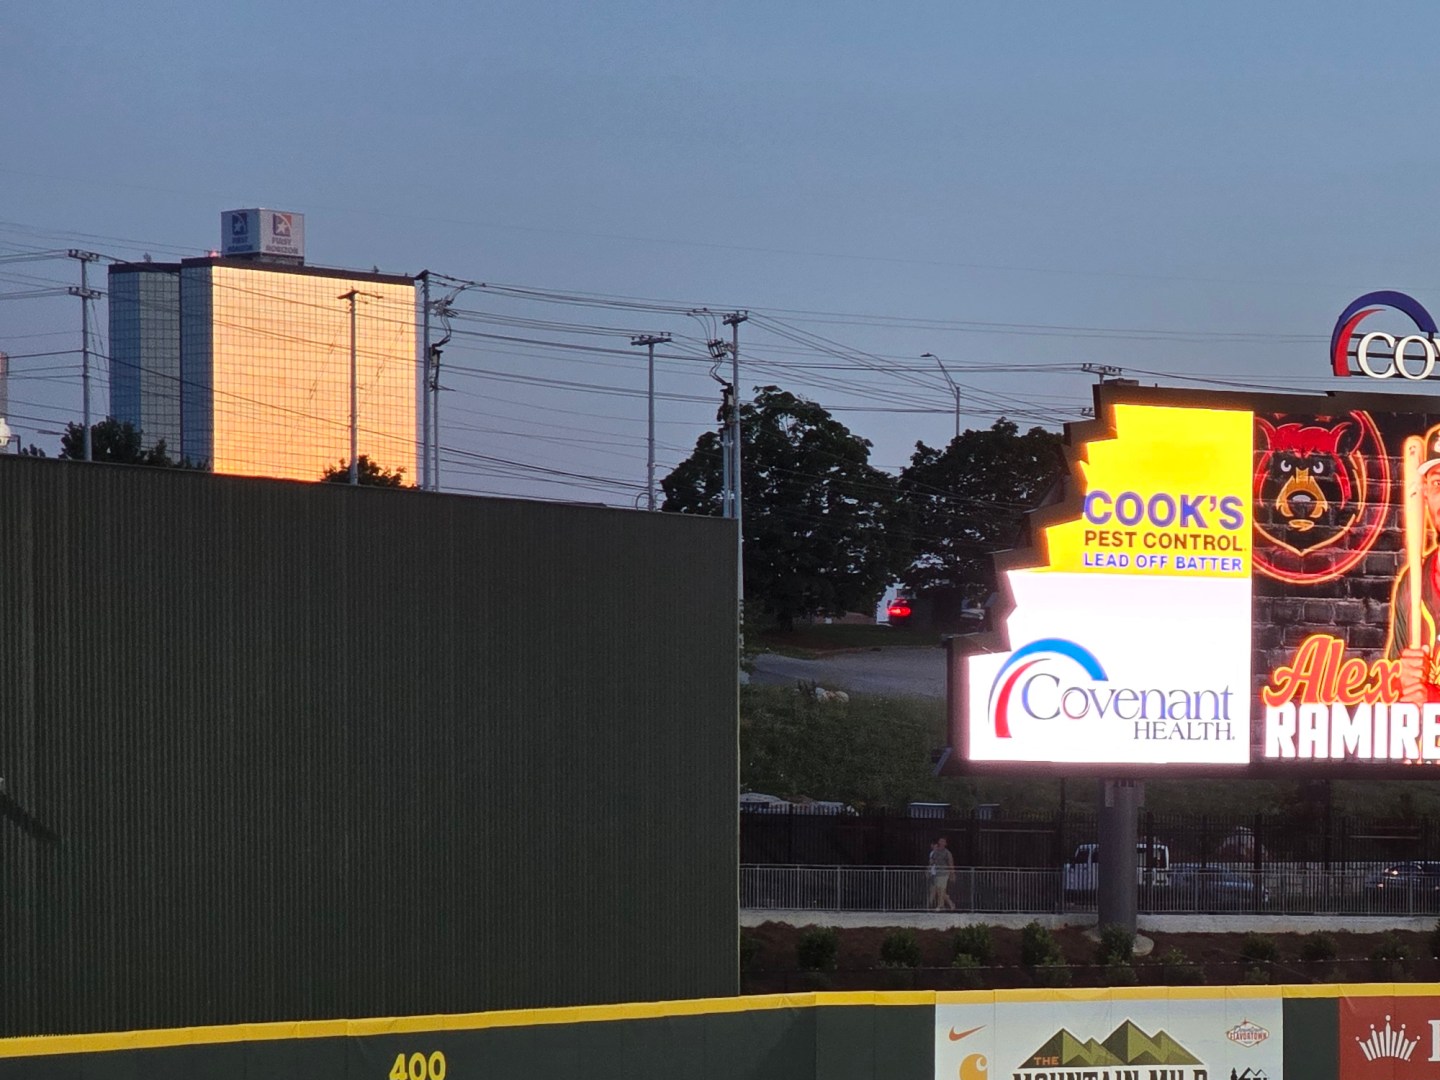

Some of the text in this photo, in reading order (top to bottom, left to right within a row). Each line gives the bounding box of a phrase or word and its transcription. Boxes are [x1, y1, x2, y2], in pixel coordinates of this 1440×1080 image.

[1083, 490, 1245, 530] COOK'S
[1084, 530, 1137, 548] PEST
[1084, 552, 1242, 571] LEAD OFF BATTER
[1263, 634, 1402, 707] Alex
[1021, 673, 1234, 721] Covenant
[1133, 721, 1232, 741] HEALTH
[1033, 1056, 1060, 1066] THE
